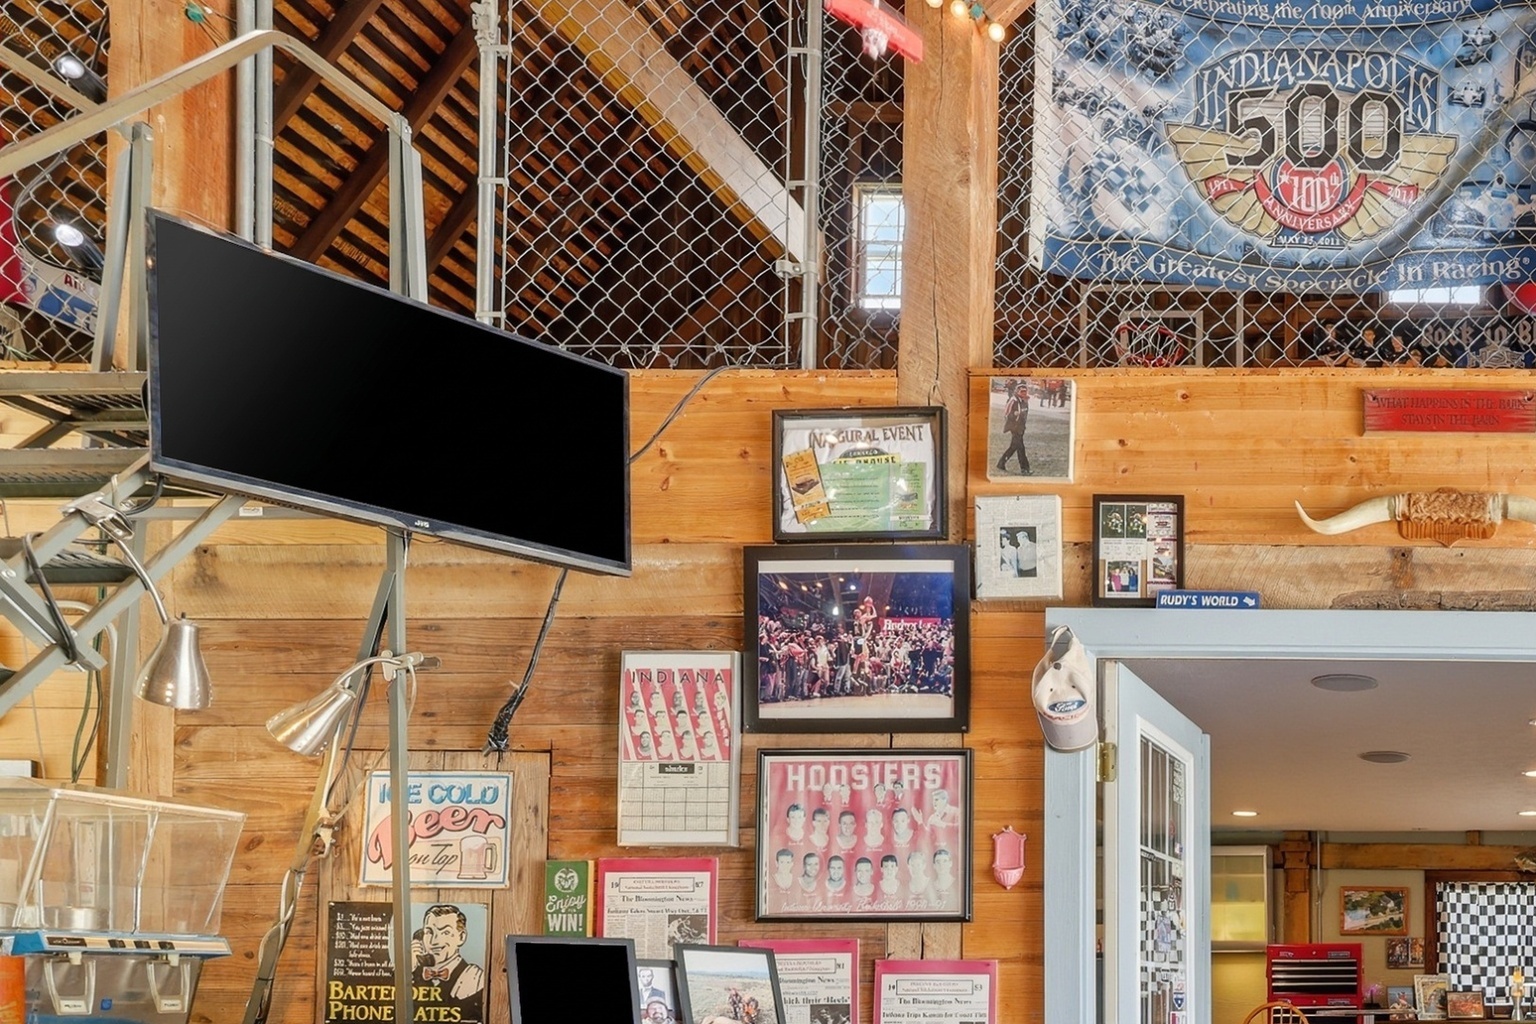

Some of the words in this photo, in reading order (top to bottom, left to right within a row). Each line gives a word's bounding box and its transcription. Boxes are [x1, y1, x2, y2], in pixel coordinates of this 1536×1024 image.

[1201, 50, 1432, 129] INDIANAPOLIS
[1225, 82, 1404, 172] 500
[1264, 198, 1355, 231] ANNIVERSARY
[1097, 249, 1139, 274] The
[1147, 253, 1256, 285] Greatest
[1399, 263, 1423, 282] In
[883, 425, 924, 441] EVENT
[1160, 595, 1198, 607] RUDY'S
[1201, 595, 1239, 607] WORLD
[632, 671, 724, 684] INDIANA
[787, 763, 942, 791] HOOSIERS
[379, 783, 422, 804] IE
[428, 783, 499, 804] COLD
[546, 894, 586, 913] Enjoy
[548, 913, 583, 932] WIN!
[329, 981, 443, 1001] BARTEER
[329, 1001, 394, 1020] PHONE
[414, 1006, 461, 1022] ATES
